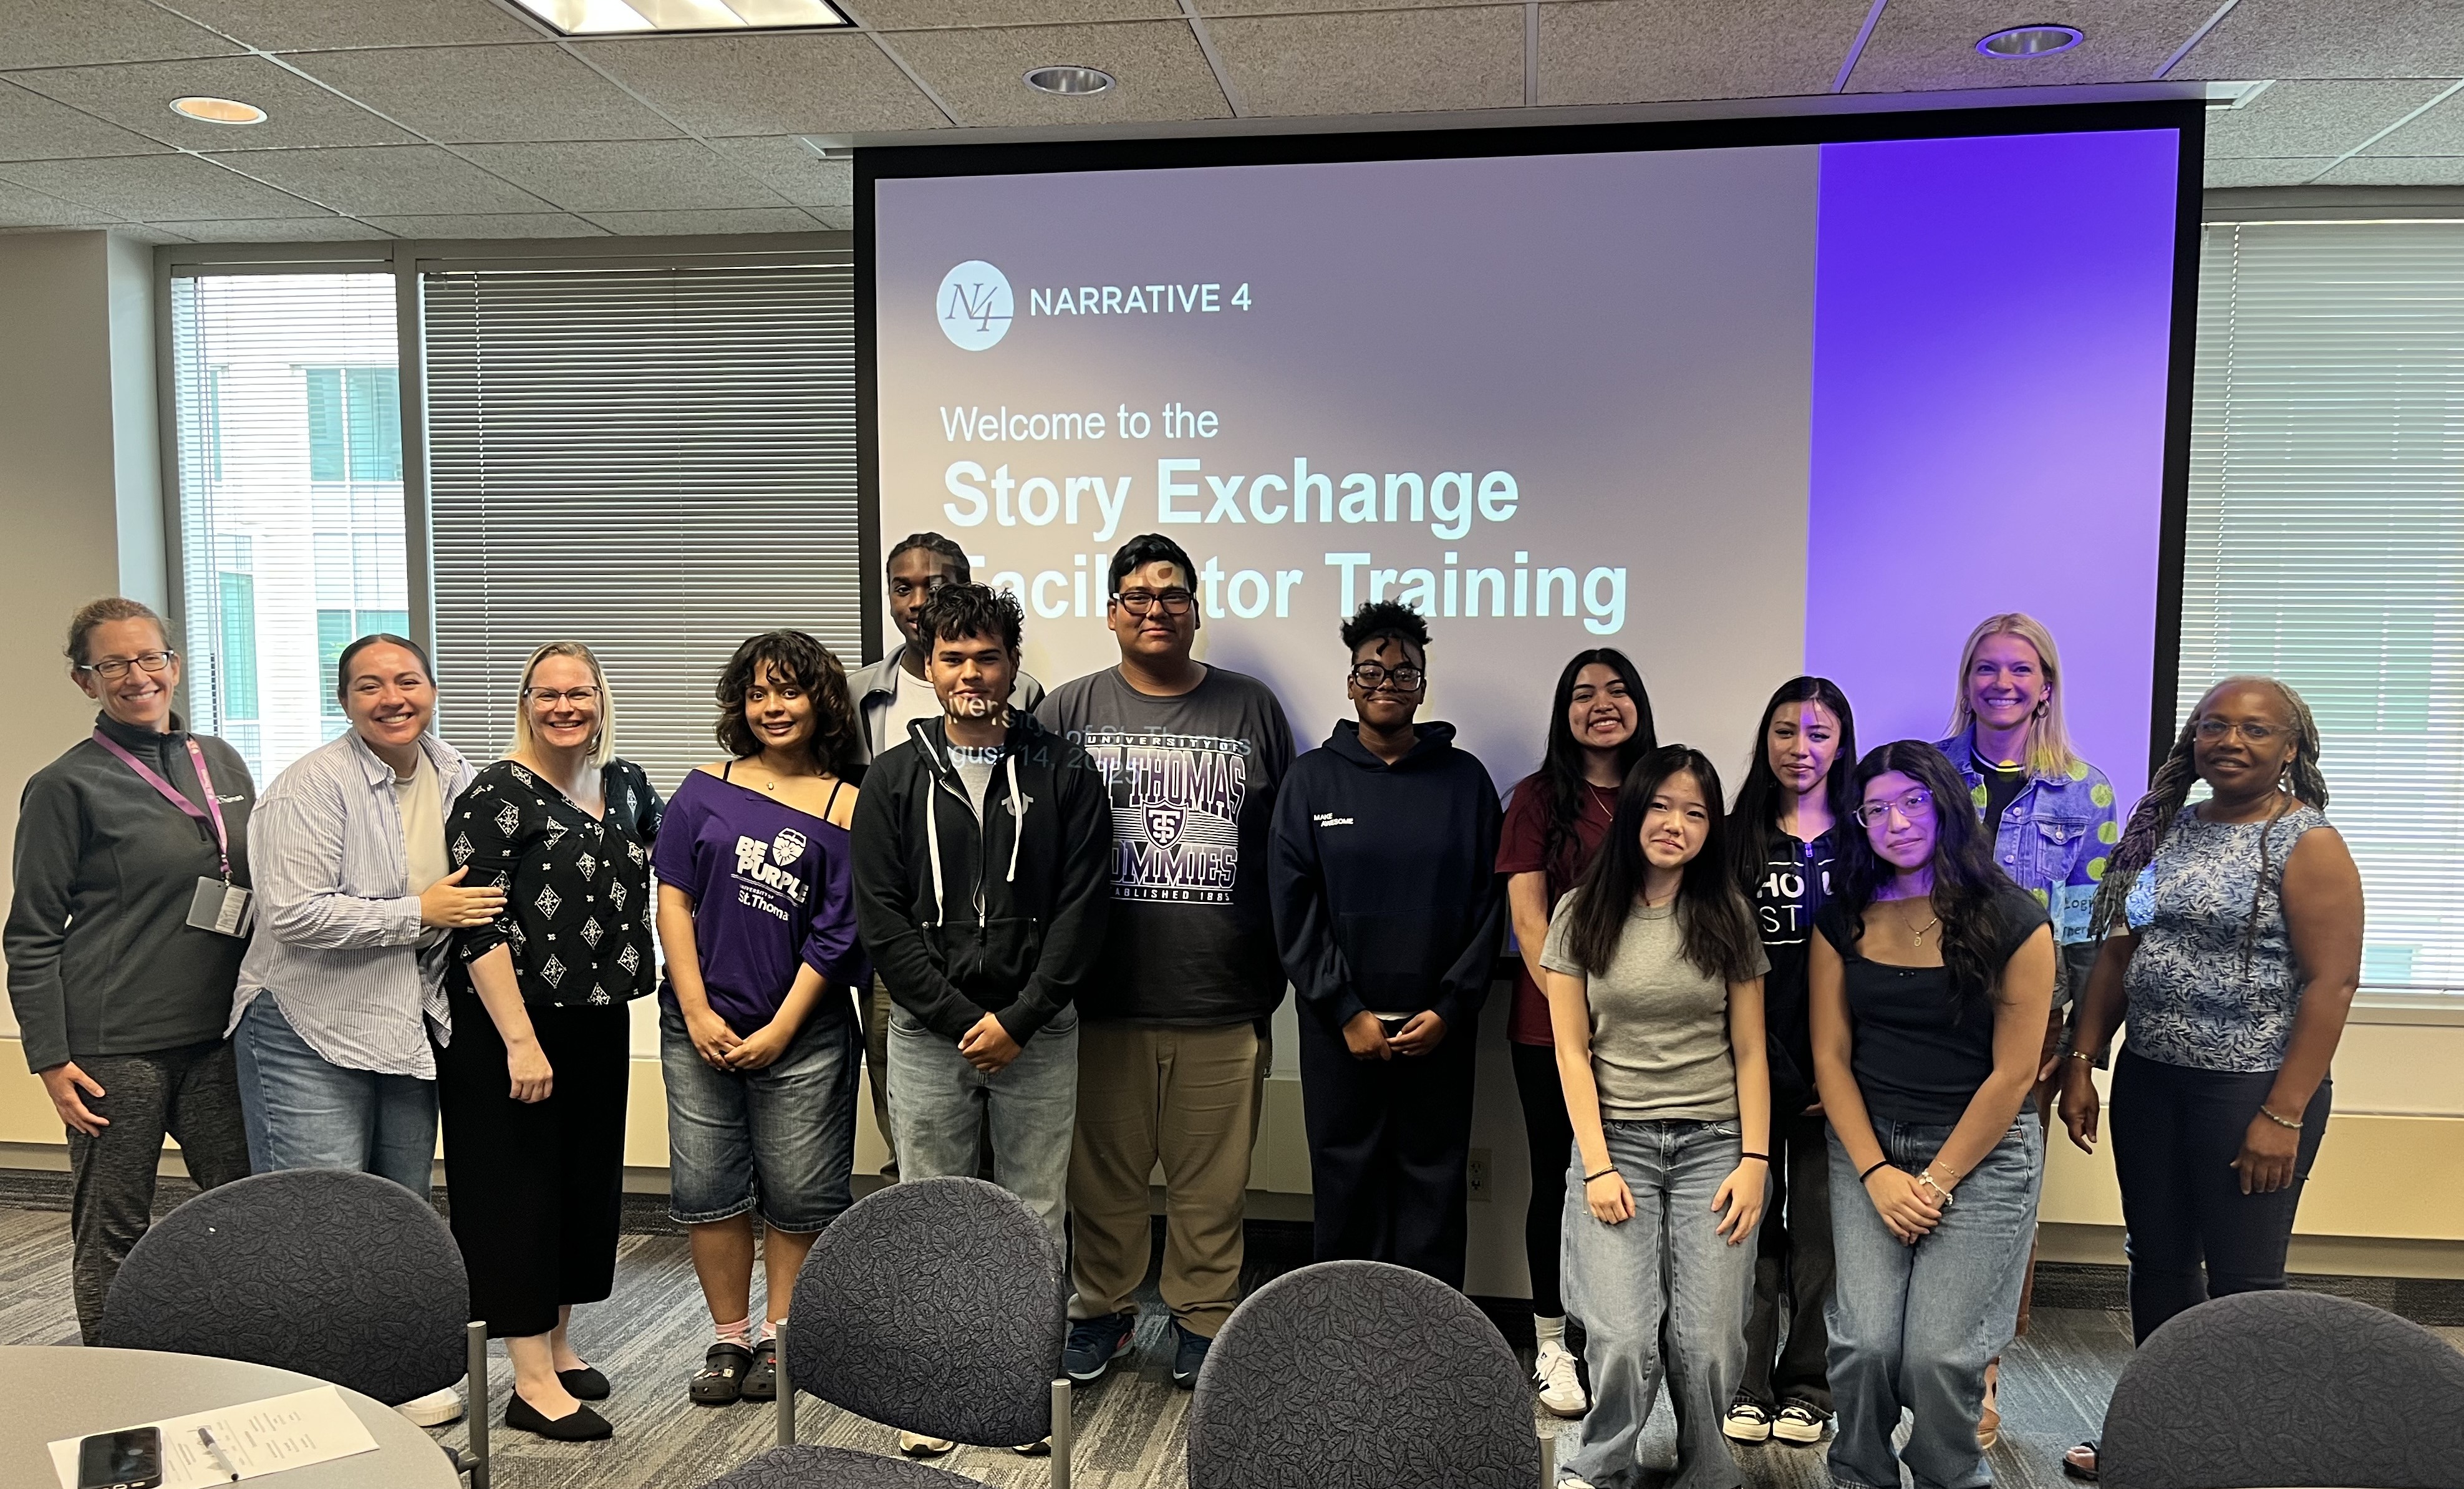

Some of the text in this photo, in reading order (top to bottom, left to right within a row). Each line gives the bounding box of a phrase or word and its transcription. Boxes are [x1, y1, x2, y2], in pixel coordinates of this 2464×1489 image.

[945, 283, 1012, 332] N4
[1030, 282, 1252, 316] NARRATIVE 4
[940, 402, 1219, 442] Welcome to the
[943, 457, 1519, 542] Story Exchange
[1325, 550, 1627, 635] Training
[1087, 735, 1240, 752] UNIVERSITY OF
[1126, 747, 1246, 828] THOMAS
[1313, 812, 1333, 821] MAKE
[1321, 818, 1354, 827] AWESOME
[735, 835, 769, 863] BE
[1109, 840, 1238, 889] OMMIES
[737, 856, 809, 903] PURPLE
[751, 894, 790, 921] Thoma
